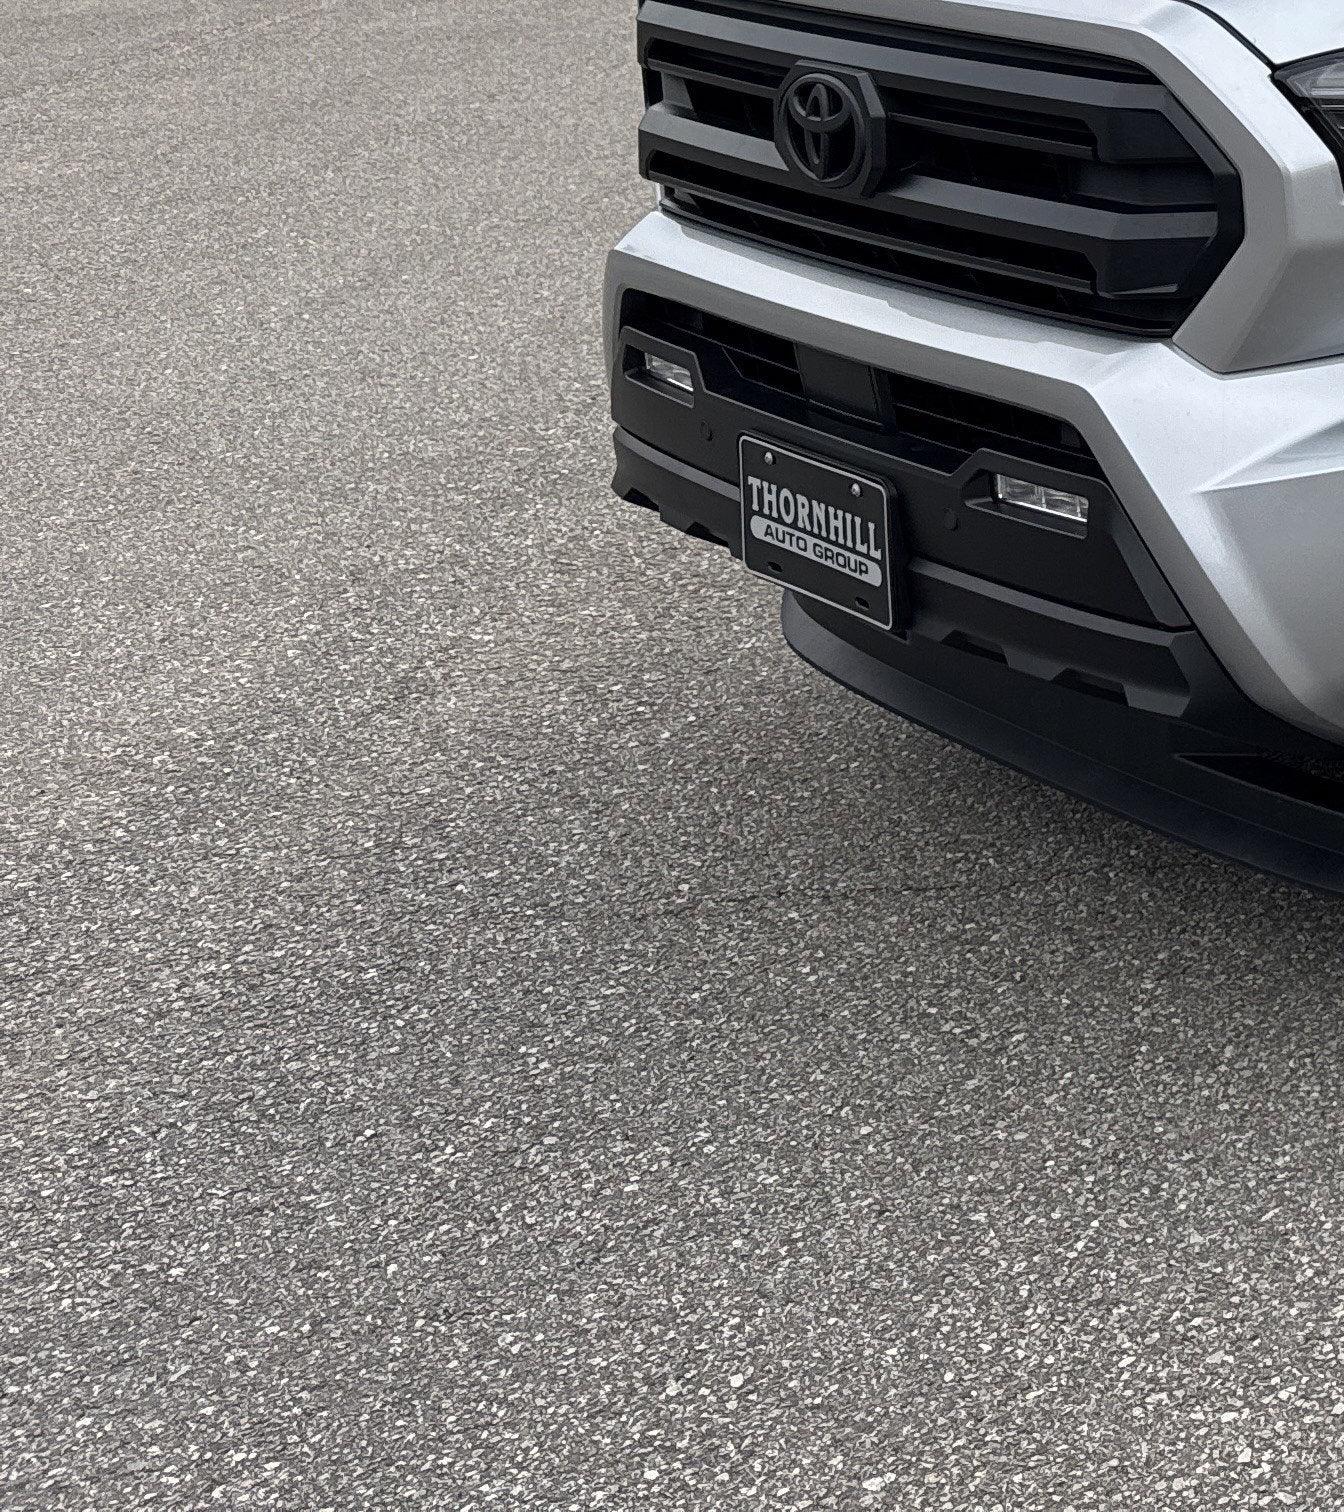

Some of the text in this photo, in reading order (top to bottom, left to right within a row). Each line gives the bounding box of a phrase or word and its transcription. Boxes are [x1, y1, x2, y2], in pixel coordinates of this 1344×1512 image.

[748, 475, 882, 561] THORNHILL
[763, 524, 869, 577] AUTO GROUP
